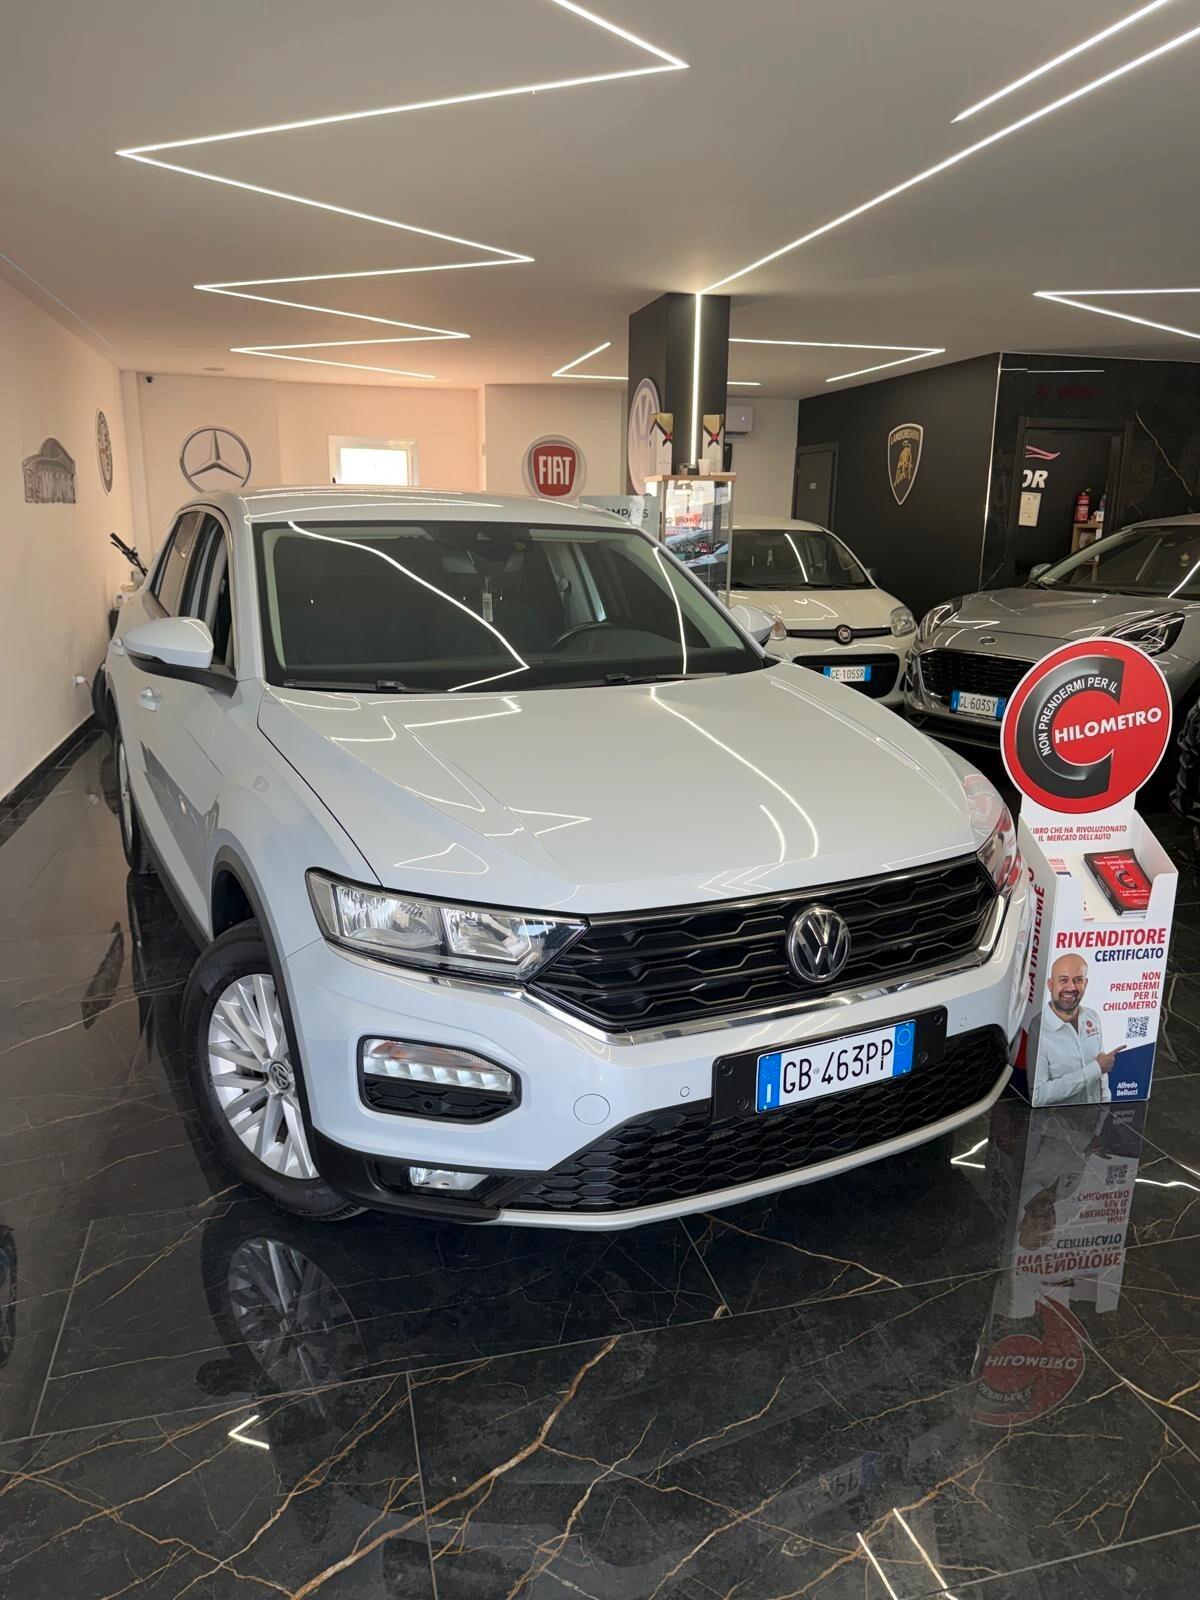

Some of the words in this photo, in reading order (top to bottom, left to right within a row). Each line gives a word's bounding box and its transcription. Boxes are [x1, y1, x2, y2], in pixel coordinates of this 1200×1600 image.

[539, 456, 572, 485] FIAT
[1087, 677, 1109, 689] PER
[1108, 681, 1118, 693] IL
[1039, 679, 1085, 730] PRENDERMI
[1054, 707, 1162, 743] HILOMETRO
[1038, 732, 1052, 756] NON
[1030, 827, 1049, 835] IBRO
[1064, 826, 1074, 834] HA
[1076, 825, 1127, 833] RIVOLUZIONATO
[1078, 833, 1111, 841] DELL'AUTO
[1056, 928, 1167, 948] RIVENDITORE
[1094, 948, 1164, 962] CERTIFICATO
[1142, 971, 1161, 980] NON
[1110, 982, 1160, 992] PRENDERMI
[1133, 991, 1150, 1000] PER
[1151, 990, 1159, 999] IL
[1103, 1000, 1157, 1011] CHILOMETRO
[821, 1038, 893, 1084] 463PP
[1117, 1081, 1138, 1089] Alfredo
[1116, 1088, 1138, 1097] Bellucci
